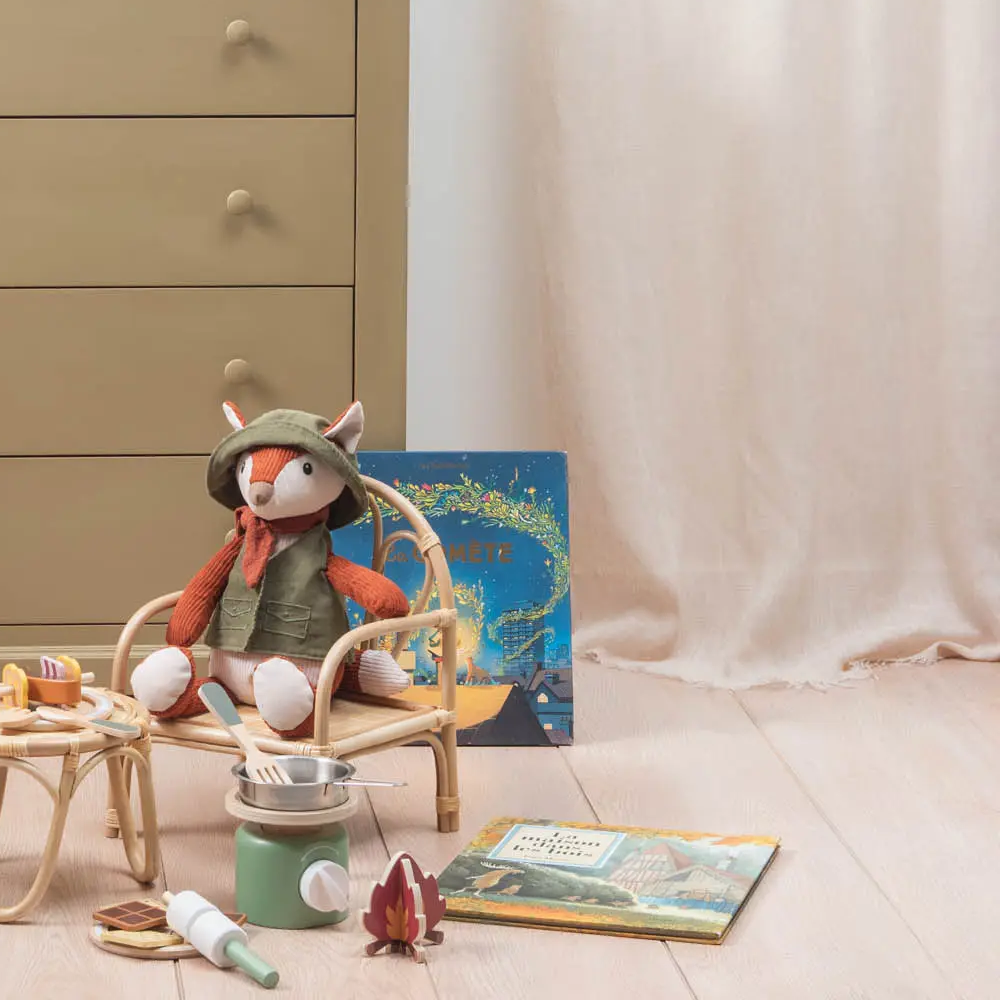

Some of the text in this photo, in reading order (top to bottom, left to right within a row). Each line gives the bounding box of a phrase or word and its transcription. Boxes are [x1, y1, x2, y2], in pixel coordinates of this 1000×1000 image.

[386, 537, 513, 563] La CMÈTE
[521, 836, 600, 847] maison
